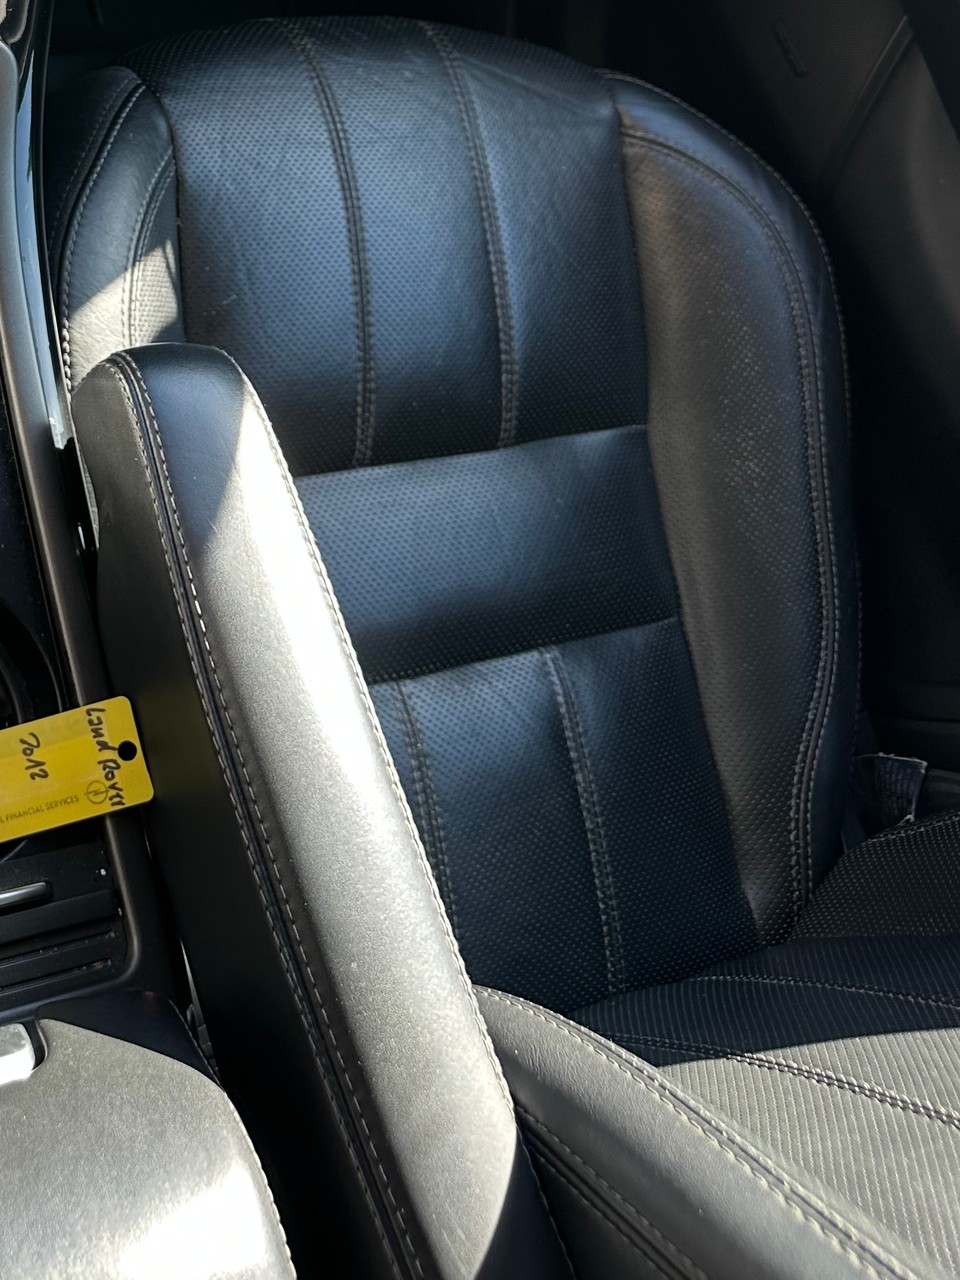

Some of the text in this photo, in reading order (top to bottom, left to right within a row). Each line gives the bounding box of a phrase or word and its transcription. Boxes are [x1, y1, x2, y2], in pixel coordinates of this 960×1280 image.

[85, 707, 119, 752] Land
[5, 805, 44, 821] FINANCIAL
[45, 794, 80, 811] SERVICES
